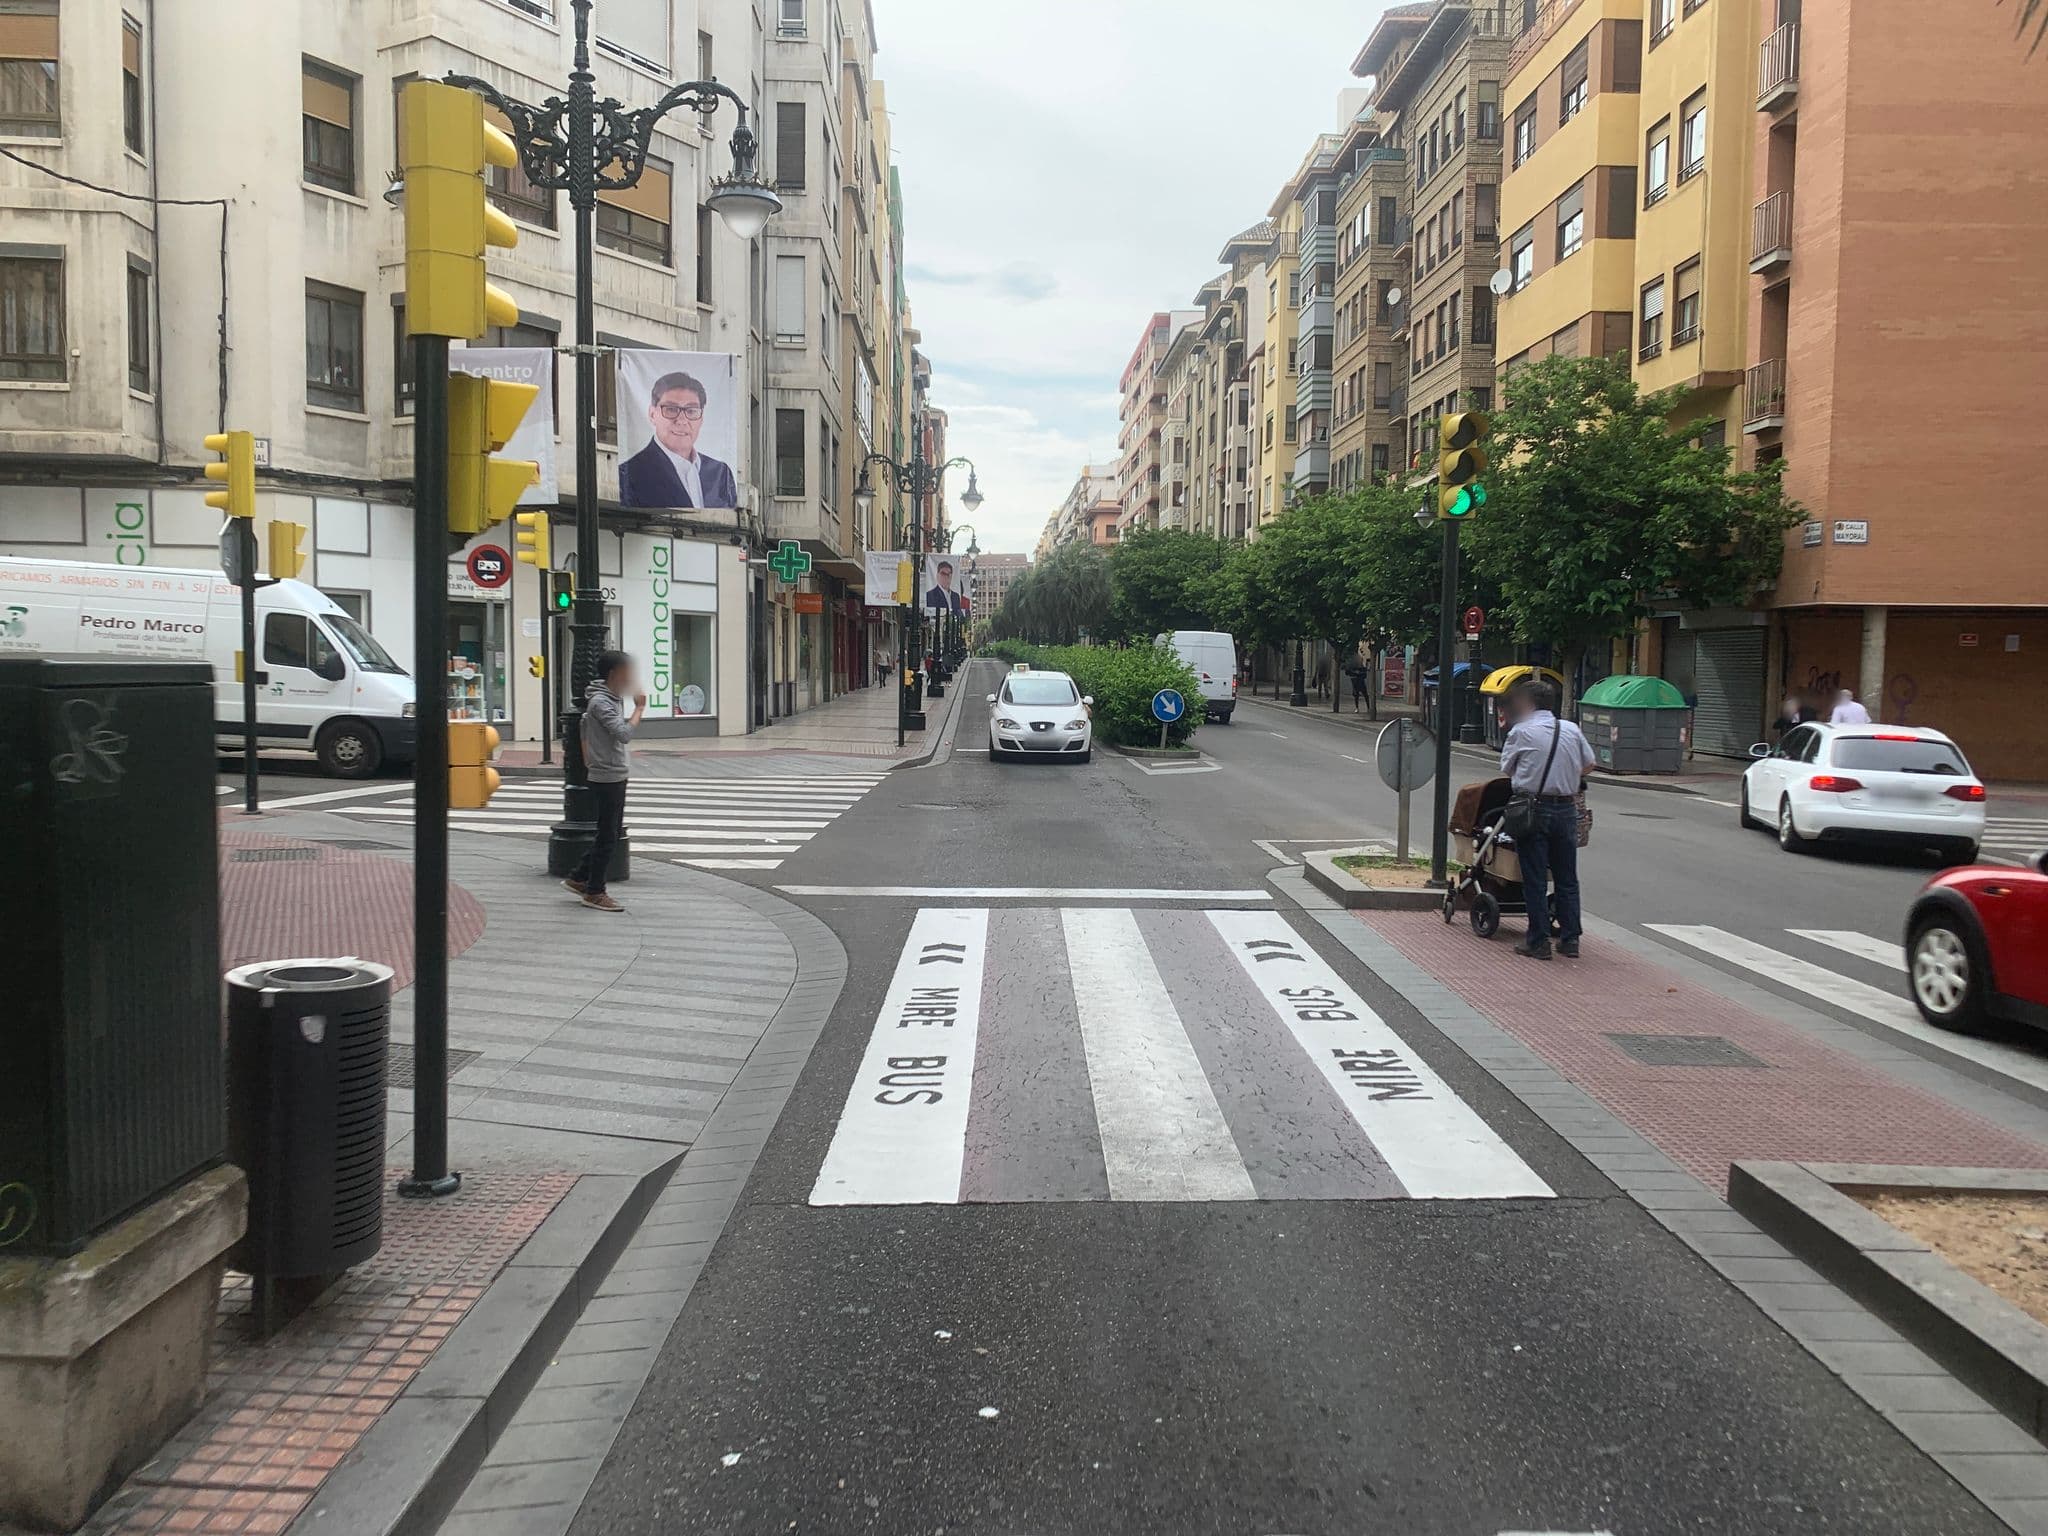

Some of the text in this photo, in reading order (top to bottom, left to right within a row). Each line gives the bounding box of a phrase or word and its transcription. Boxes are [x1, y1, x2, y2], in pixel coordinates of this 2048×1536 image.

[472, 364, 533, 378] centro
[0, 571, 51, 583] RICAMOS
[60, 575, 119, 588] ARMARIOS
[127, 579, 145, 589] SIN
[152, 580, 171, 591] FIN
[192, 583, 207, 593] SU
[80, 615, 204, 634] Pedro Marco
[648, 546, 669, 708] Farmacia
[874, 987, 960, 1105] MIRE BUS
[1278, 987, 1434, 1101] MIRE BUS
